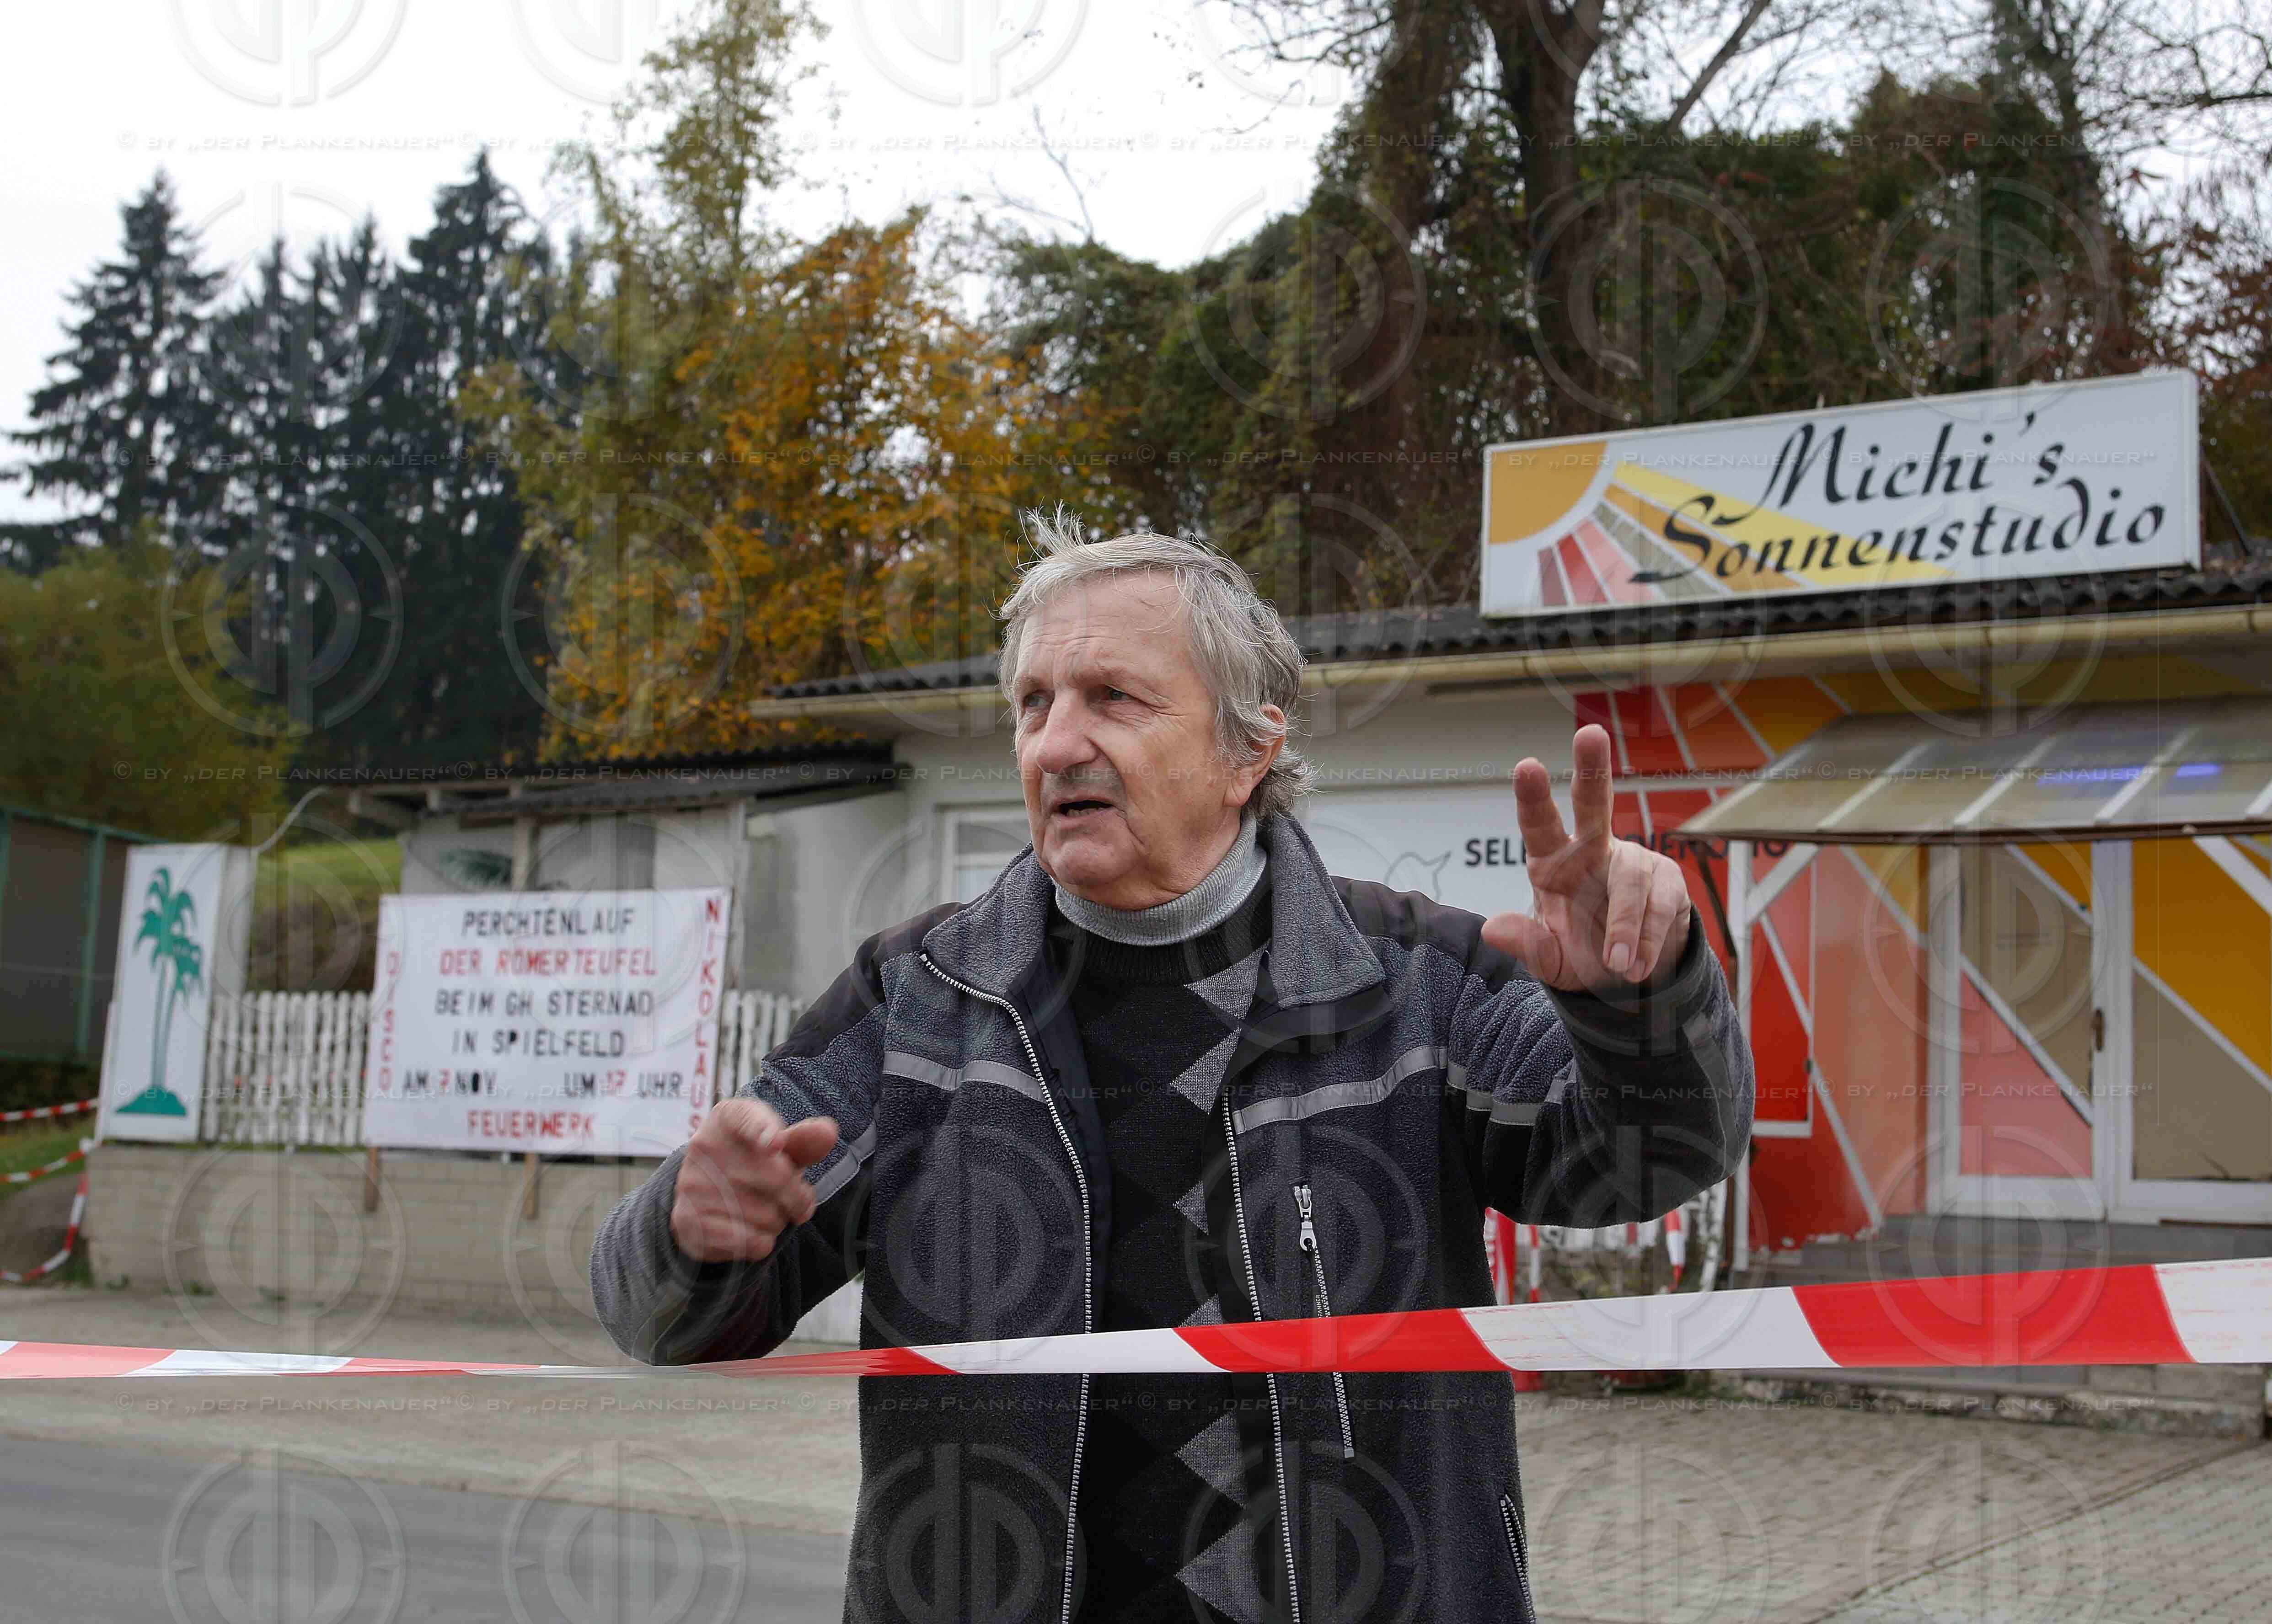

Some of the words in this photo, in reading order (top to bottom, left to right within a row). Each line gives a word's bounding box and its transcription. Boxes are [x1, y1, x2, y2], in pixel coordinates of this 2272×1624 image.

[1712, 411, 2064, 525] Michi's
[1628, 477, 2165, 583] Sonnenstudio
[461, 908, 636, 939] PERCHTENLAUF
[439, 948, 481, 977] DER
[435, 989, 494, 1016] BEIM
[505, 990, 533, 1016] GH
[548, 989, 654, 1016] STERNAD
[452, 1029, 478, 1055] IN
[492, 1029, 625, 1058] SPIELFELD
[403, 1069, 430, 1093] AM
[456, 1069, 498, 1094] NOV
[564, 1071, 595, 1096] UM
[639, 1072, 683, 1098] UHR
[467, 1110, 596, 1139] FEUERWERK
